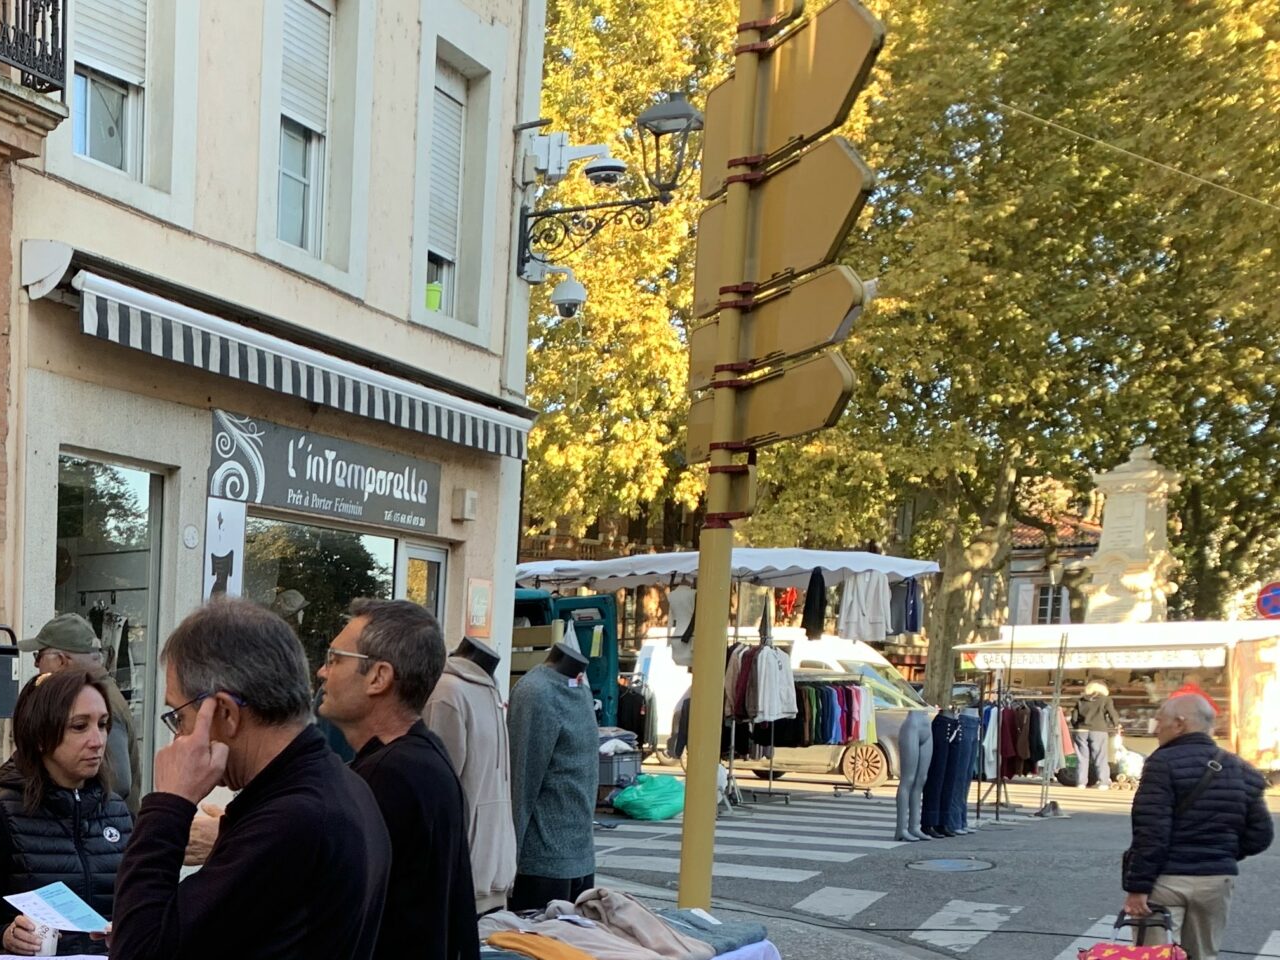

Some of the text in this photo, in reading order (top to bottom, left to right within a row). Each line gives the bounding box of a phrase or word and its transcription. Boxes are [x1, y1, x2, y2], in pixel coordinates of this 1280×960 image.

[287, 488, 363, 516] Prêt à Porter Féminin
